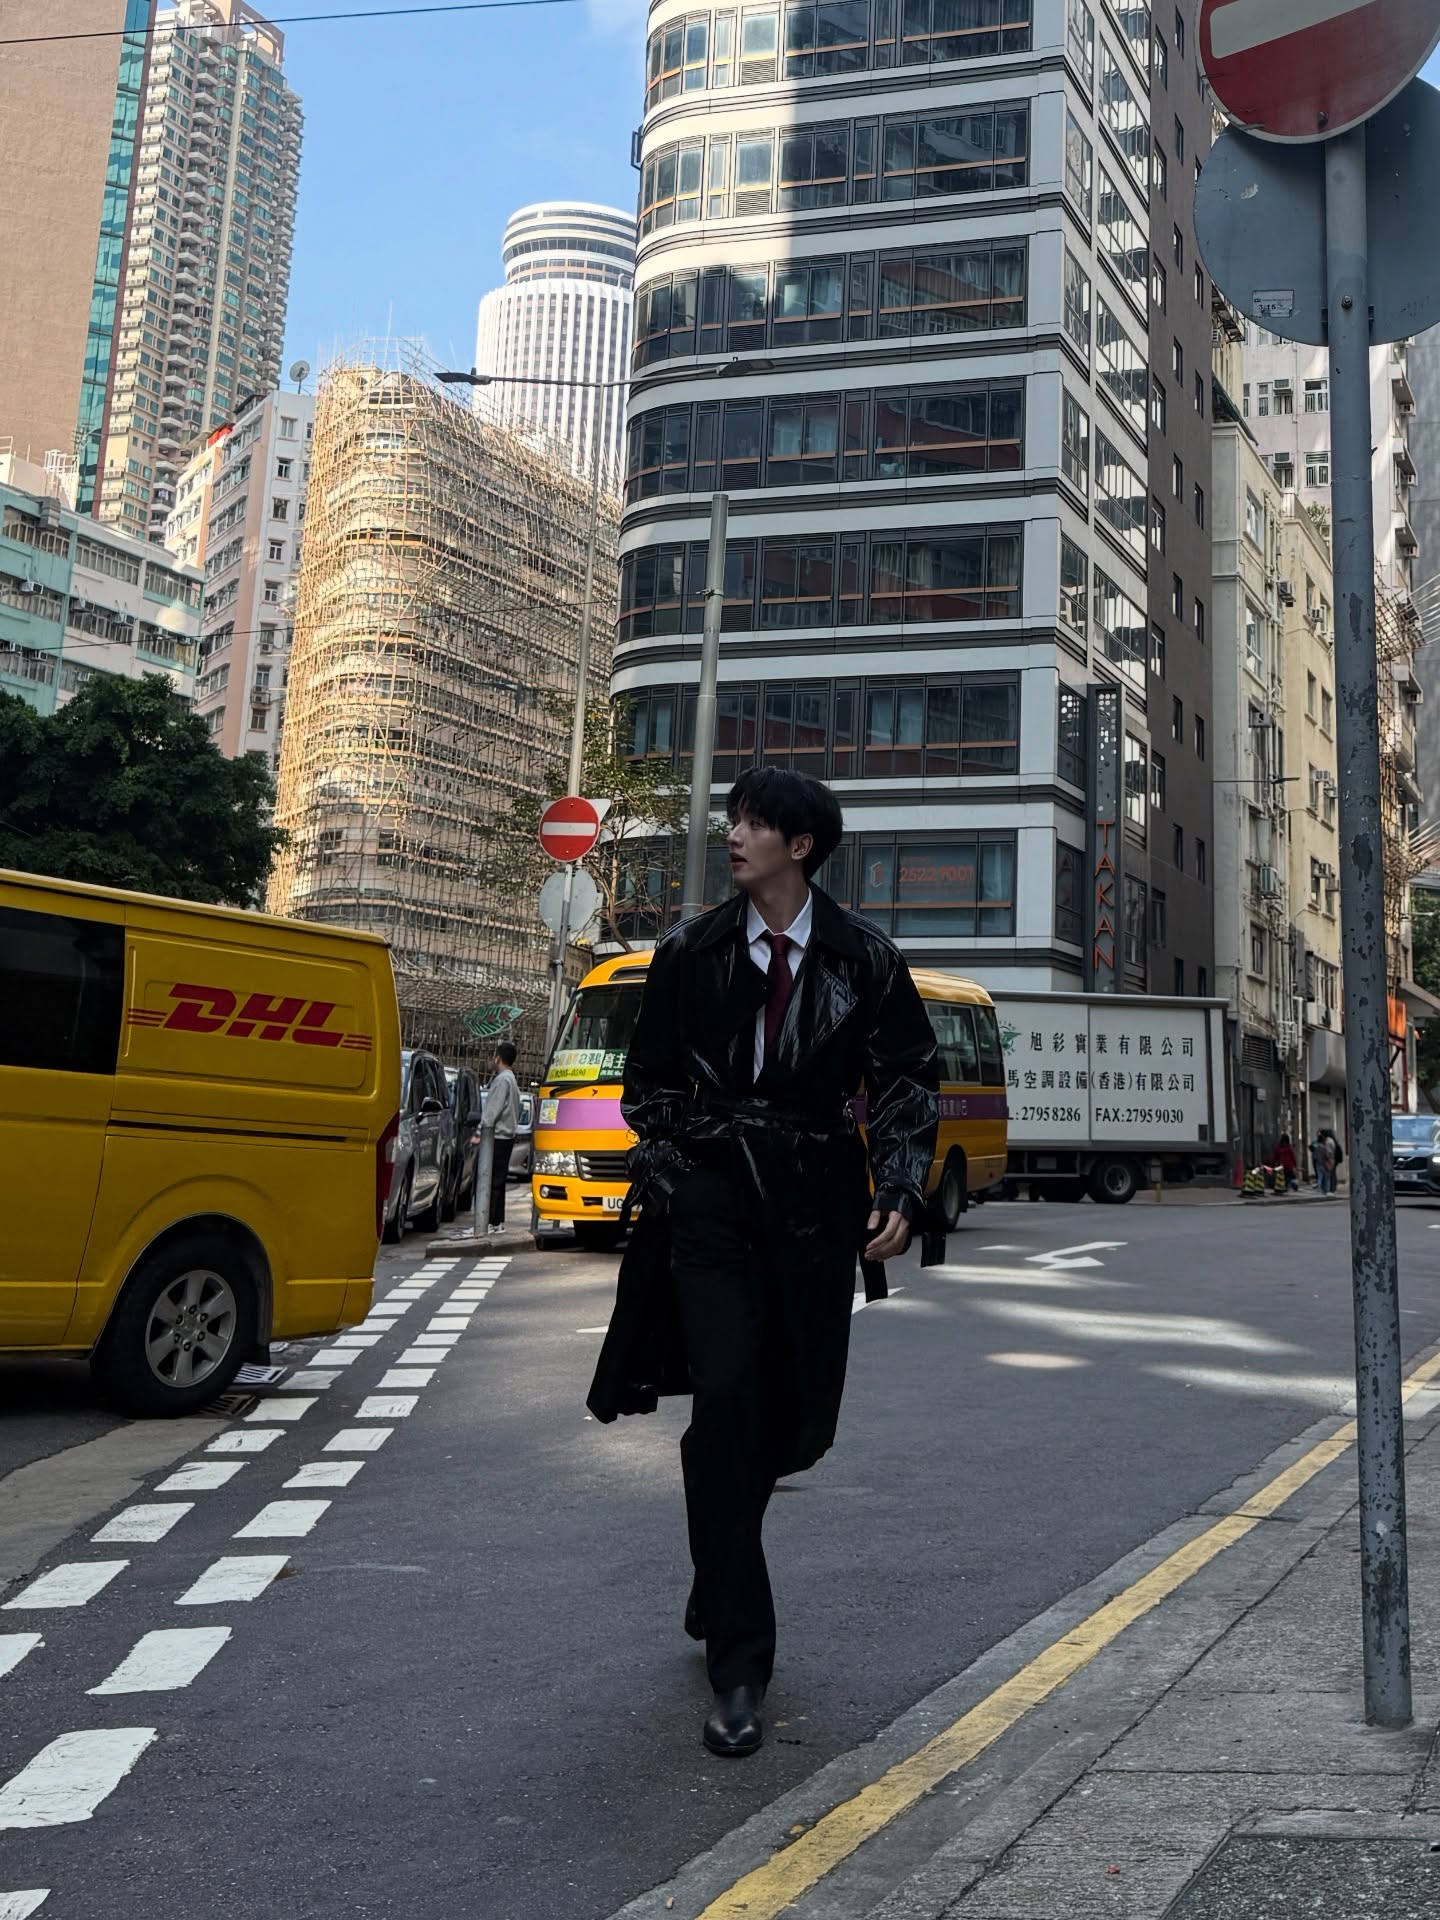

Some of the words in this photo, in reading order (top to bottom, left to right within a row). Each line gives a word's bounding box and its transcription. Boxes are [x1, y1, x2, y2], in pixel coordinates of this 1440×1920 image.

[1093, 818, 1116, 971] TAKAN
[163, 982, 345, 1048] DHL
[1030, 1031, 1194, 1057] 旭彩實業有限公司
